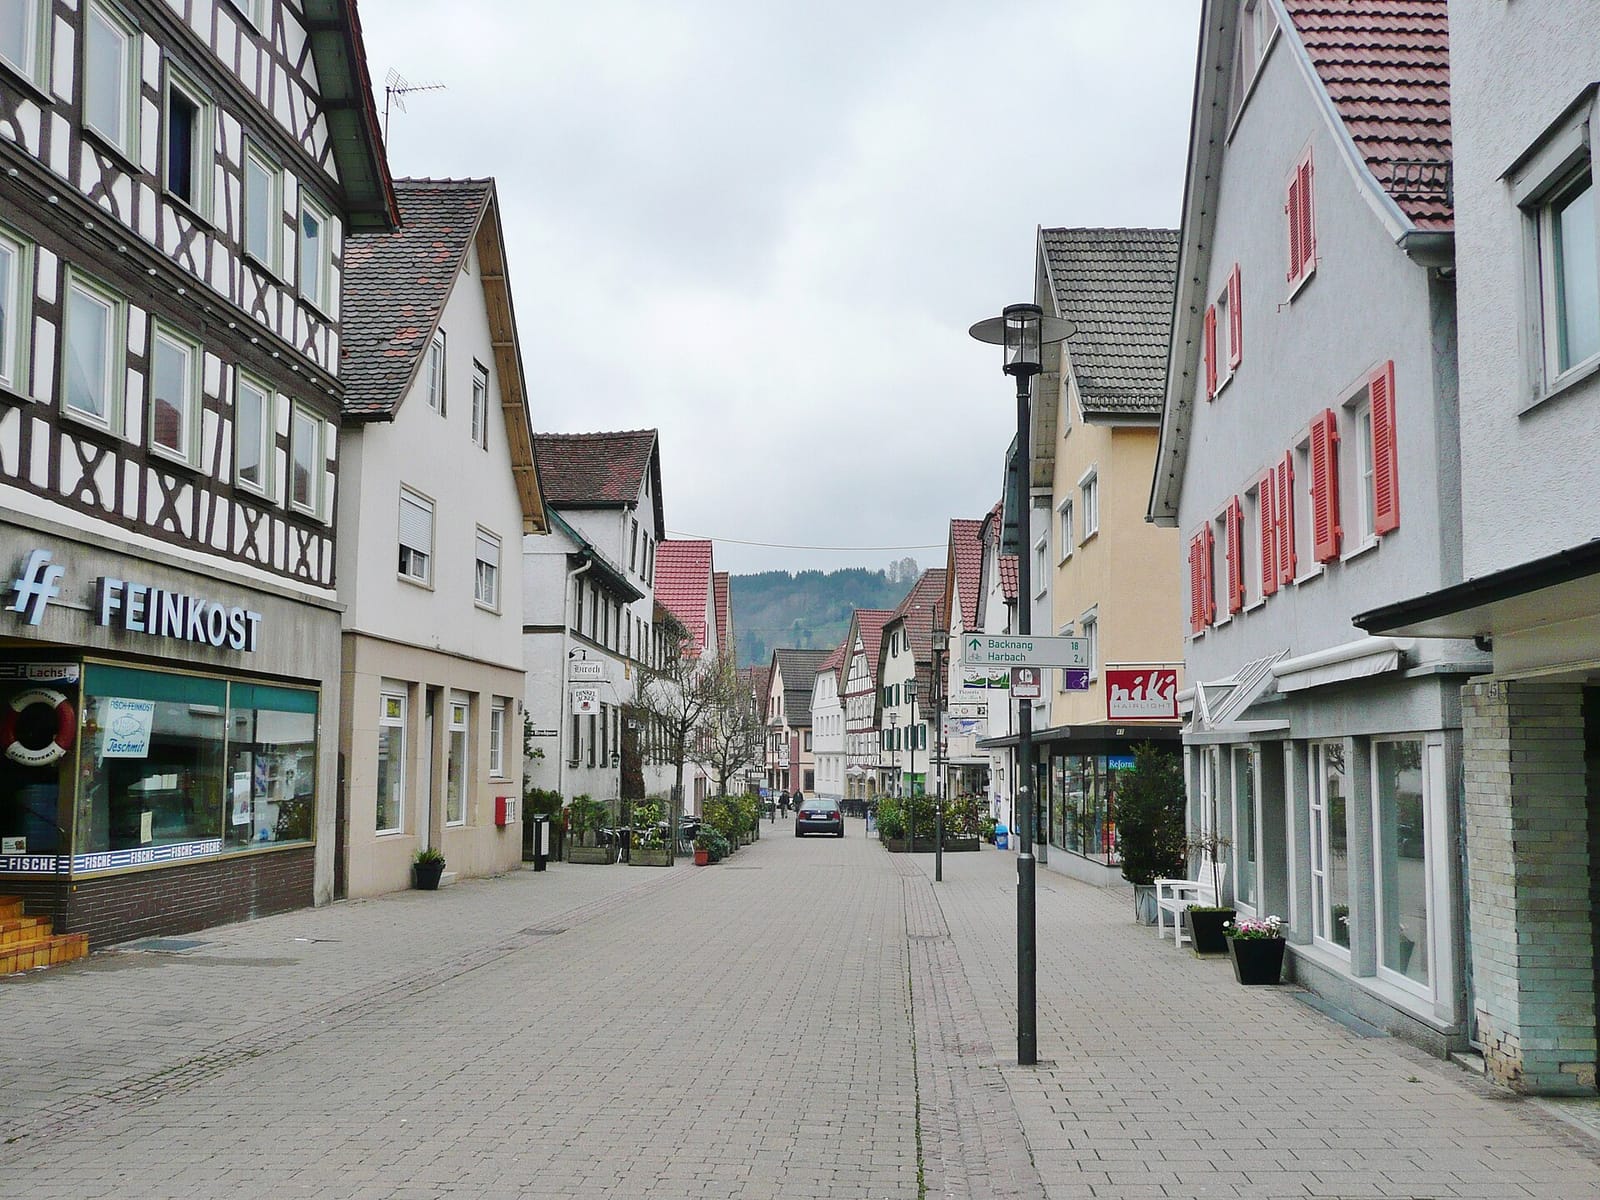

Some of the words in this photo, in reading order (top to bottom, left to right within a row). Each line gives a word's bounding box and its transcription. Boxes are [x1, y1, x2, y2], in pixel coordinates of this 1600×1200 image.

[97, 576, 262, 652] FEINKOST
[988, 640, 1033, 651] Backnang
[1071, 642, 1079, 650] 18
[988, 652, 1026, 661] Harbach
[30, 668, 67, 677] Lachs!
[1110, 671, 1175, 702] niki
[85, 854, 112, 869] FISCHE
[130, 850, 154, 864] FISCHE
[171, 845, 193, 858] FISCHE
[200, 842, 220, 854] FISCHE
[9, 858, 57, 871] FISCHE
